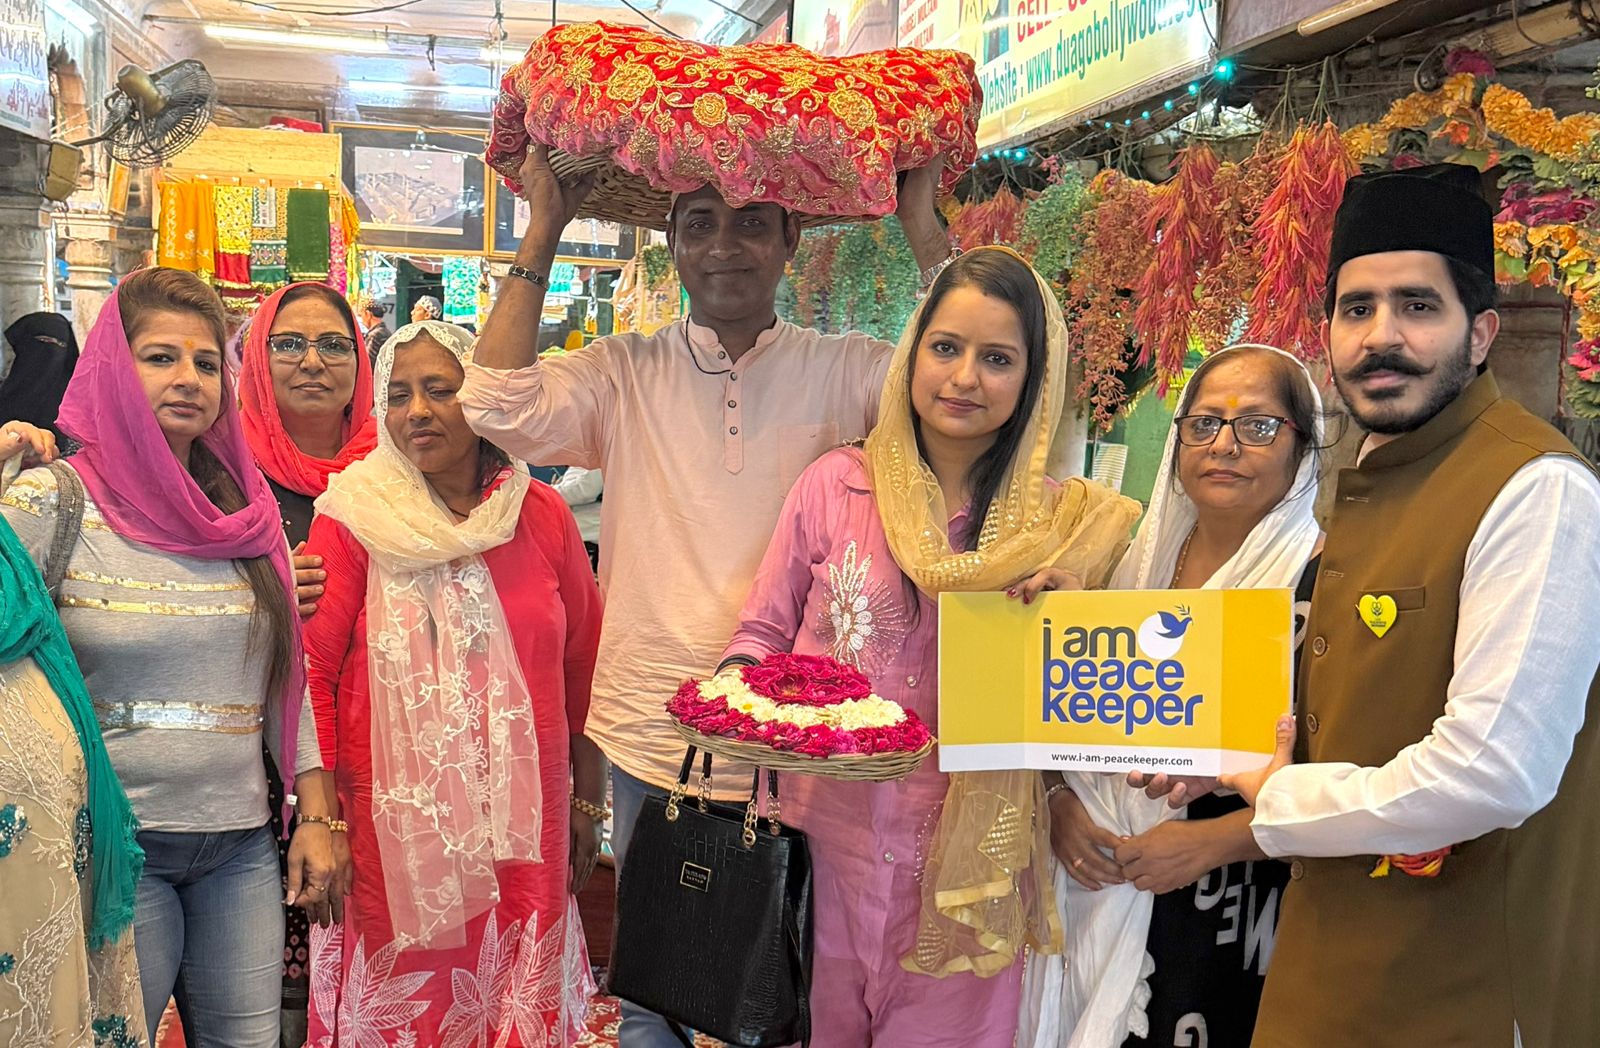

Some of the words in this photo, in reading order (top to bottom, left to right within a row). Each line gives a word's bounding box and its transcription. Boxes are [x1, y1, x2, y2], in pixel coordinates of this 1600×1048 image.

[1043, 618, 1052, 660] i
[1063, 626, 1136, 658] am
[1043, 658, 1185, 692] peace
[1042, 690, 1203, 735] keeper
[1051, 752, 1193, 767] www.i-am-peacekeeper.com
